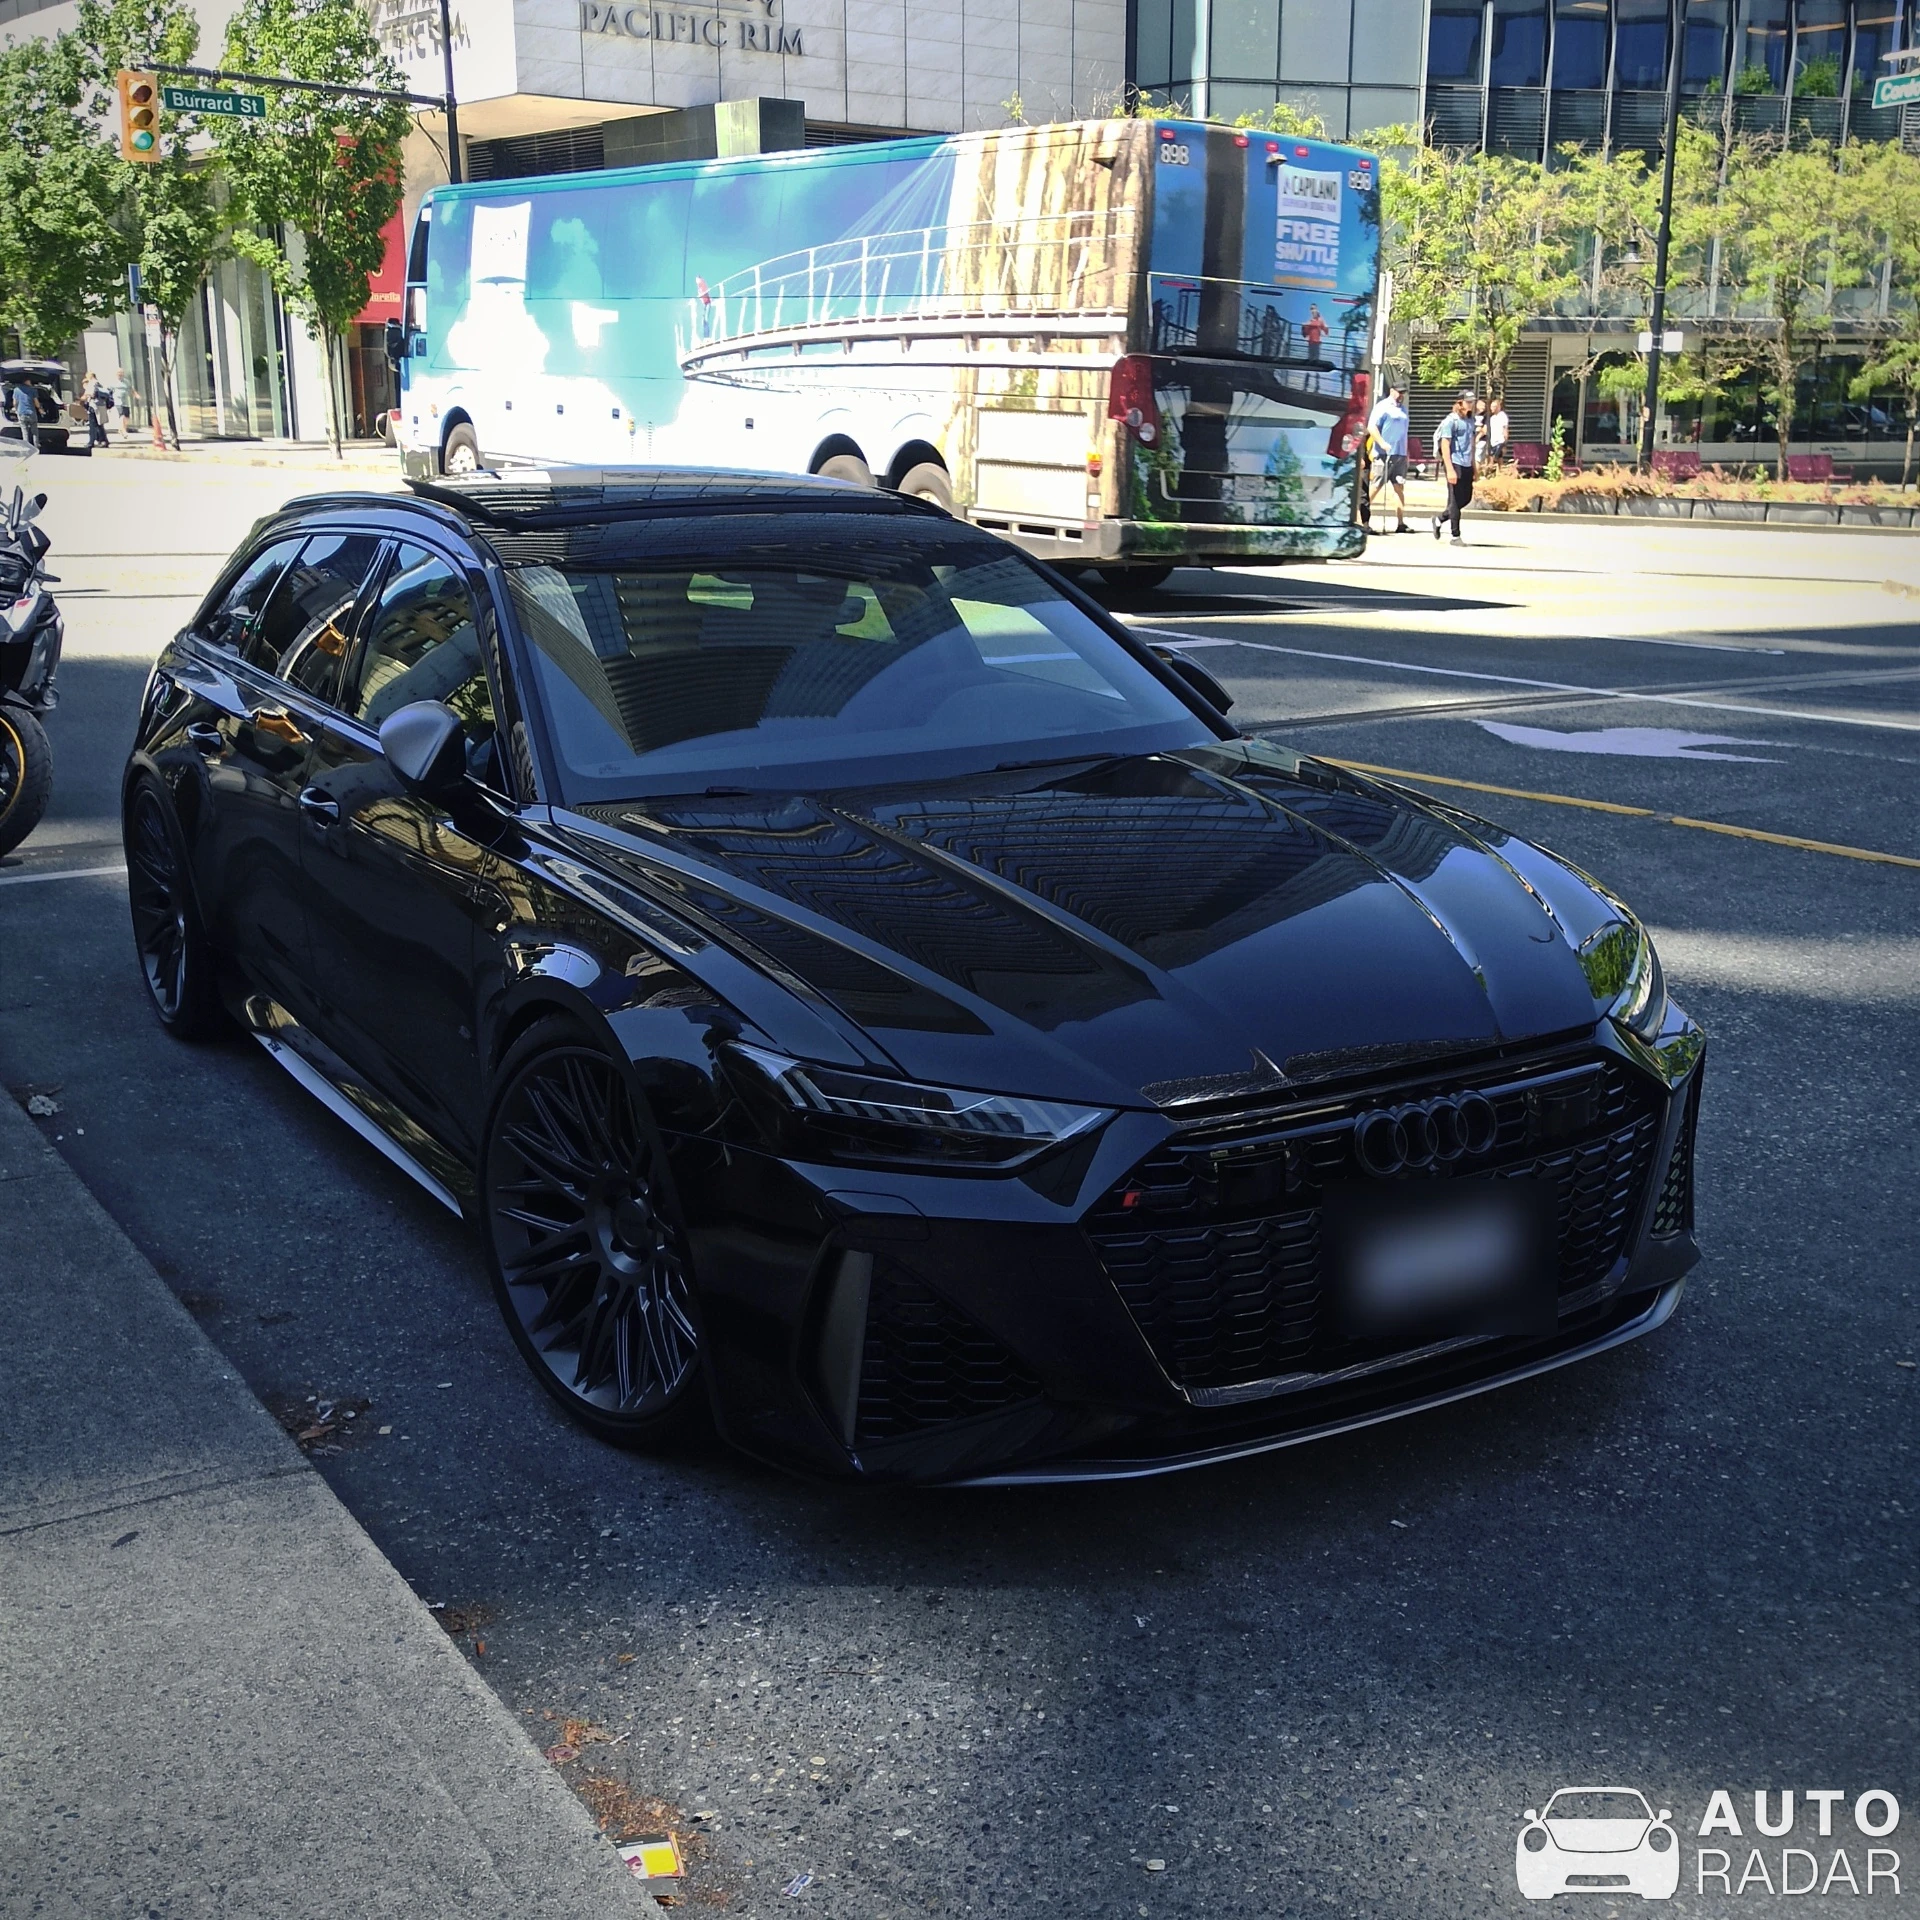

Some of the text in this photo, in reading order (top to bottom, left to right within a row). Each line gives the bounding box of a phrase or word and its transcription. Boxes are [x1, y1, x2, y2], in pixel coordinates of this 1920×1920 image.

[582, 2, 806, 56] PACIFIC RIM
[172, 91, 259, 114] Burrard St
[1161, 143, 1190, 165] 898
[1276, 218, 1340, 247] FREE
[1275, 240, 1339, 266] SHUTTLE
